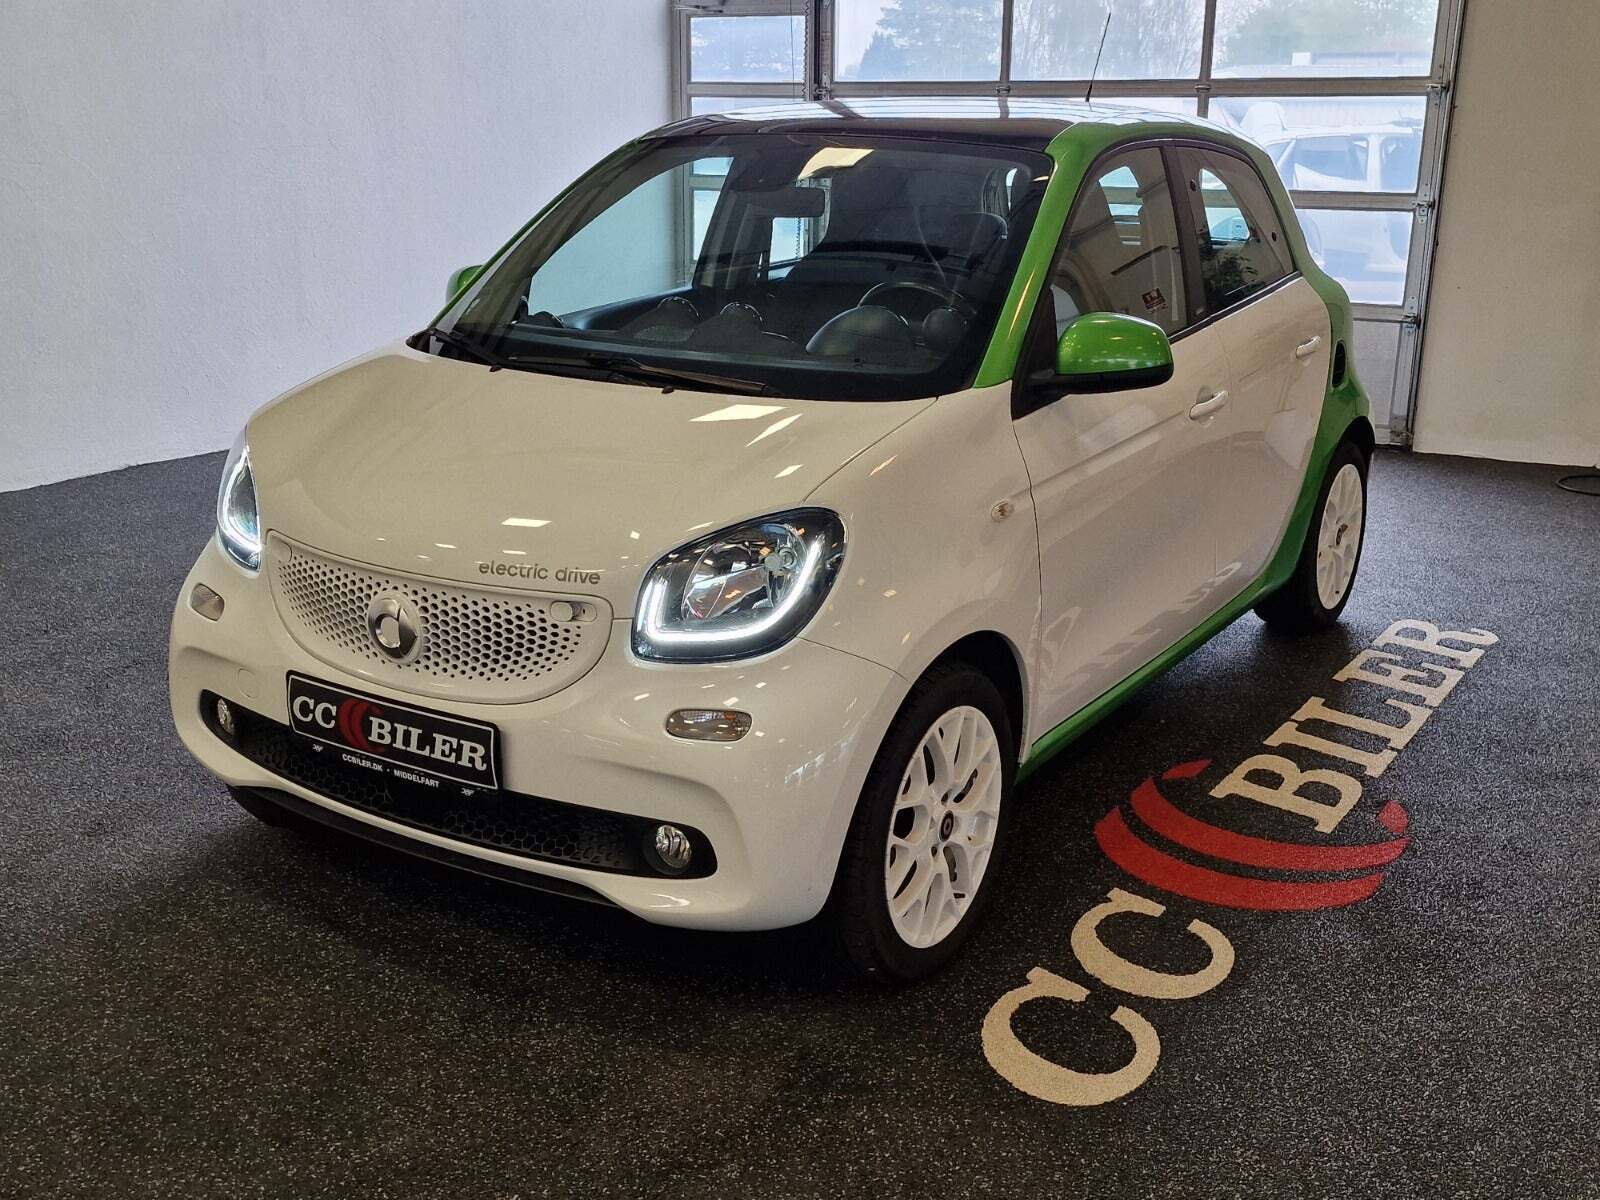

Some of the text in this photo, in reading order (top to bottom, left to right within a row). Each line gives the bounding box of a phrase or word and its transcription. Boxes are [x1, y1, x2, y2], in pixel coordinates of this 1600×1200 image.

[479, 560, 601, 585] electric drive
[292, 695, 487, 771] CC BILER
[342, 753, 440, 788] CCBILER.DK MIDDELFART
[981, 618, 1500, 1107] CC BILER
